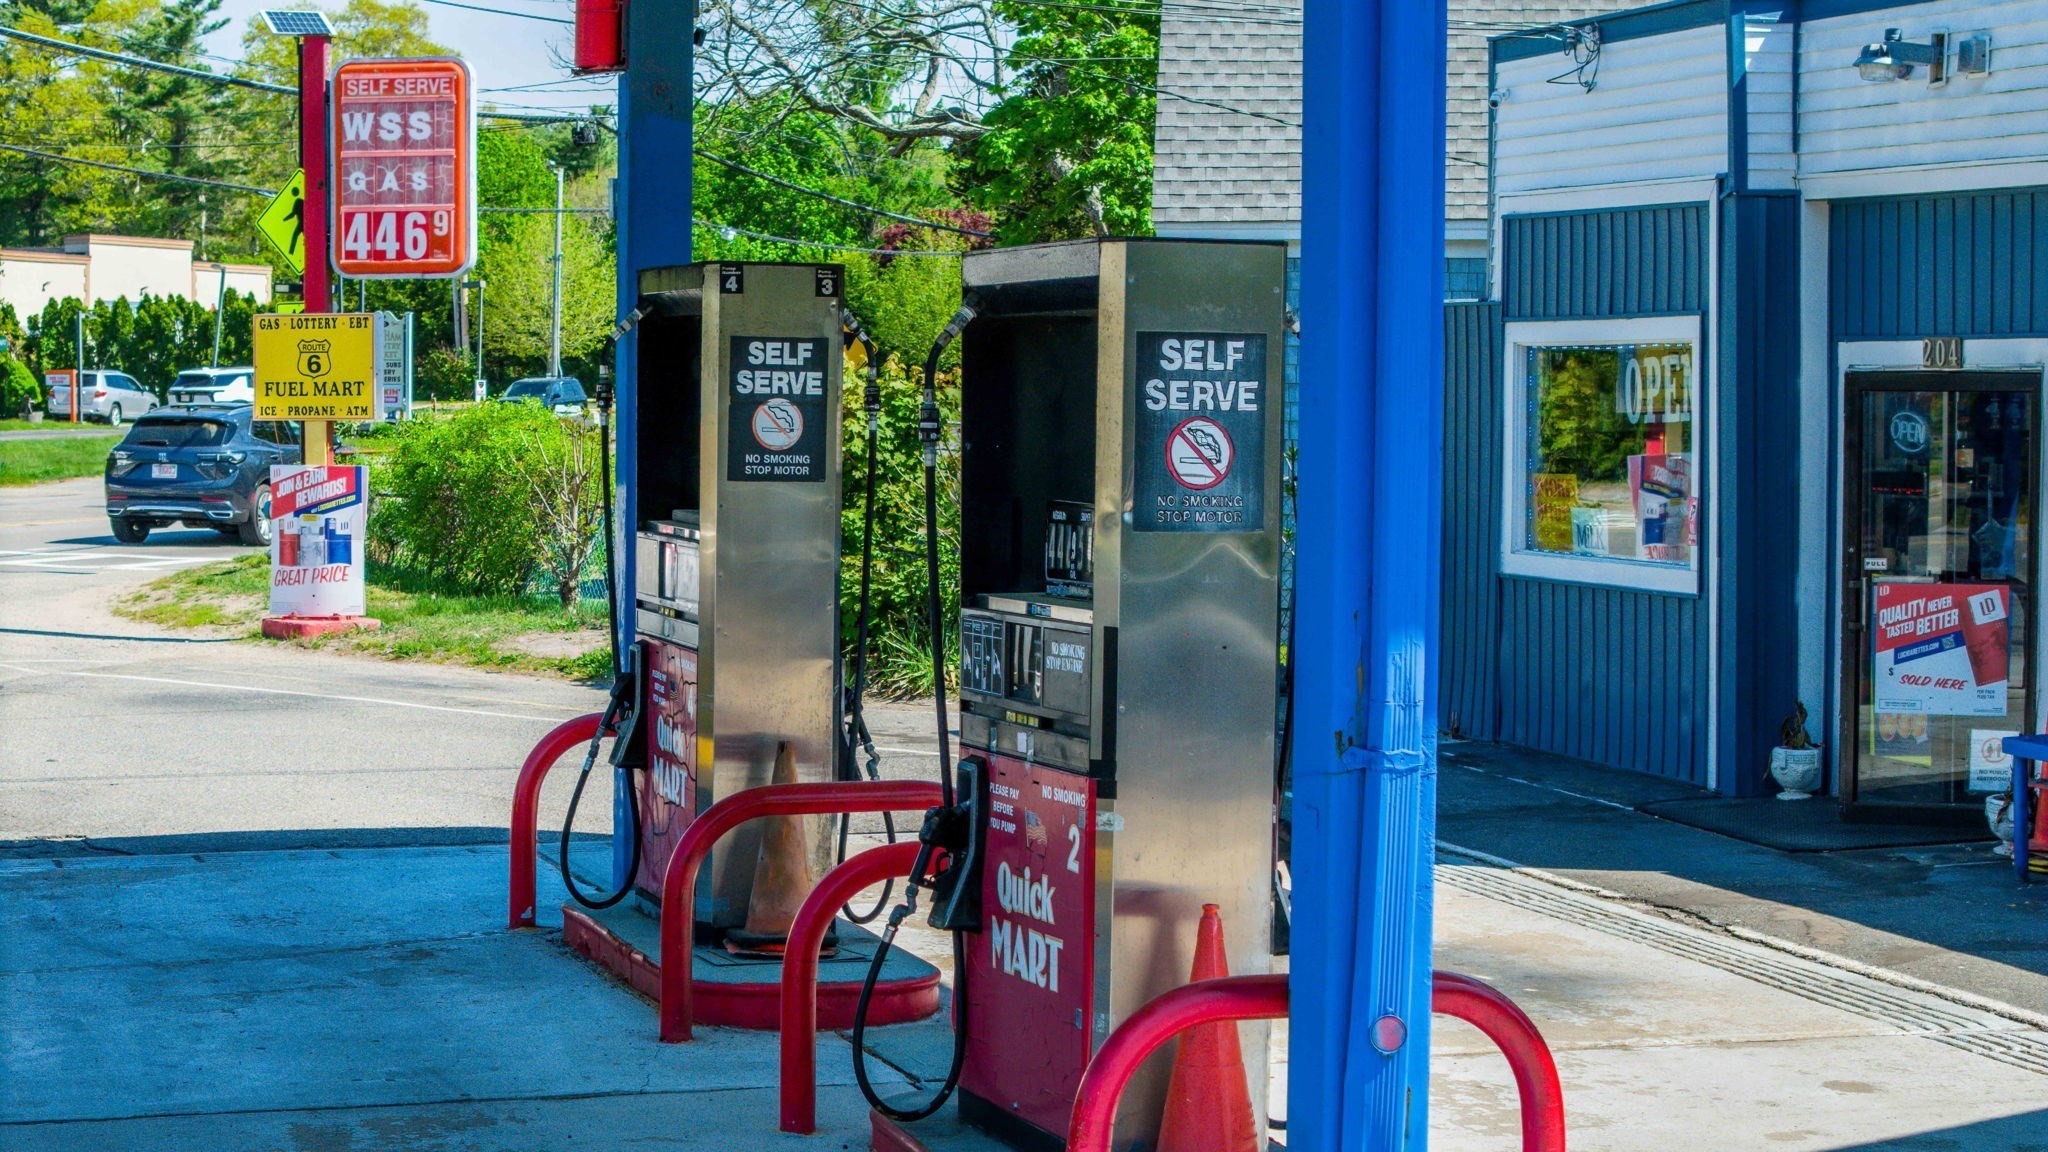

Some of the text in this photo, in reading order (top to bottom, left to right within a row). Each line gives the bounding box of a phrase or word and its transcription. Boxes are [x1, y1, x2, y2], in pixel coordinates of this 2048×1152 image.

[346, 78, 451, 96] SELF SERVE
[343, 111, 432, 142] WSS
[348, 171, 429, 192] GAS
[725, 276, 738, 292] 4
[821, 279, 833, 295] 3
[259, 316, 369, 330] GAS LOTTERY EBT
[748, 341, 814, 366] SELF
[1159, 339, 1245, 371] SELF
[1923, 339, 1958, 366] 204
[306, 354, 322, 374] 6
[264, 380, 365, 397] FUEL MART
[736, 370, 823, 396] SERVE
[1145, 378, 1259, 412] SERVE
[260, 405, 369, 416] ICE PROPANE ATM
[1890, 418, 1926, 444] OPEN
[745, 454, 810, 464] NO SMOKING
[745, 464, 809, 475] STOP MOTOR
[276, 467, 328, 498] JOIN & EARN
[296, 477, 347, 508] REWARDS!
[1157, 495, 1243, 508] NO SMOKING
[1157, 510, 1243, 523] STOP MOTOR
[274, 566, 349, 587] GREAT PRICE
[1879, 595, 1953, 629] QUALITY NEVER
[1979, 597, 1996, 616] LD
[1885, 609, 1959, 639] TASTED BETTER
[1051, 641, 1085, 659] NO SMOKING
[1046, 656, 1083, 674] STOP ENGINE
[1899, 674, 1968, 690] SOLD HERE
[656, 713, 685, 758] Quick
[653, 754, 687, 809] MART
[989, 782, 1020, 800] PLEASE PAY
[1041, 784, 1086, 807] NO SMOKING
[992, 800, 1014, 817] BEFORE
[1000, 820, 1016, 835] PUMP
[1067, 824, 1080, 874] 2
[996, 861, 1056, 925] Quick
[991, 915, 1063, 993] MART
